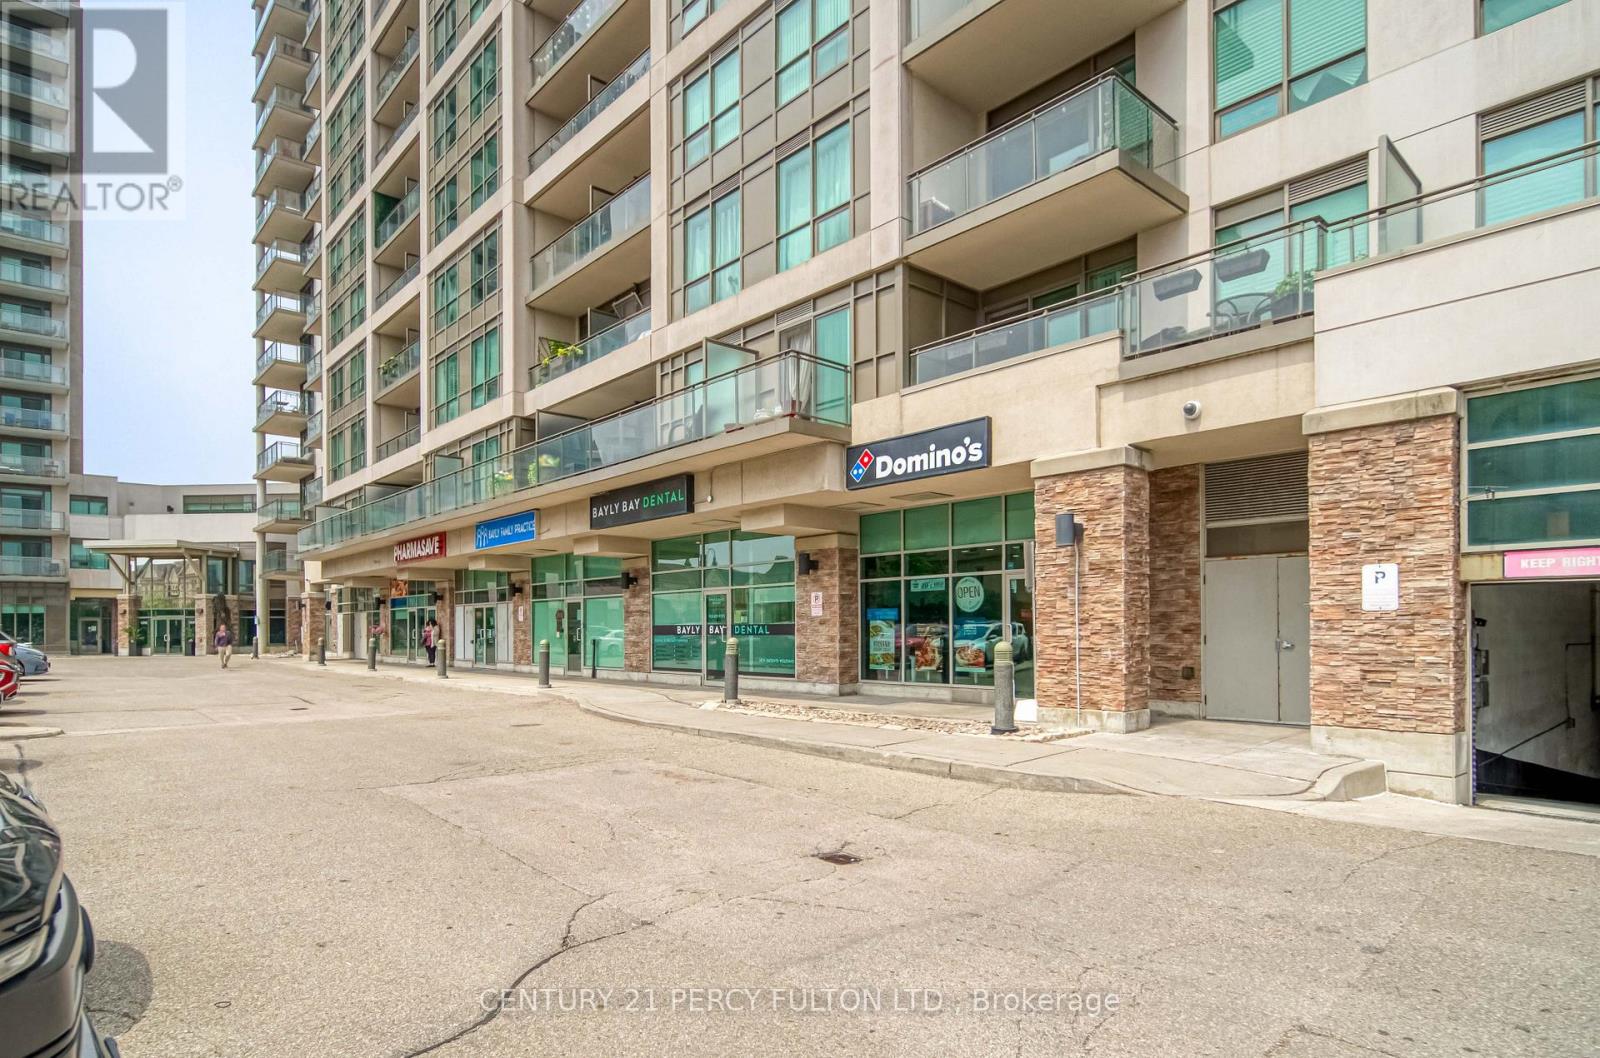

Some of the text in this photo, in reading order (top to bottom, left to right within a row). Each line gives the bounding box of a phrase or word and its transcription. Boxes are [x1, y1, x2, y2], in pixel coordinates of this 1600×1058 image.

[875, 436, 983, 479] Domino's
[592, 489, 685, 519] BAYLY BAY DENTAL
[393, 535, 440, 562] PHARMASAVE
[1520, 557, 1556, 569] KEEP
[957, 586, 981, 599] OPEN
[676, 625, 770, 634] BAYLY BAY DENTAL
